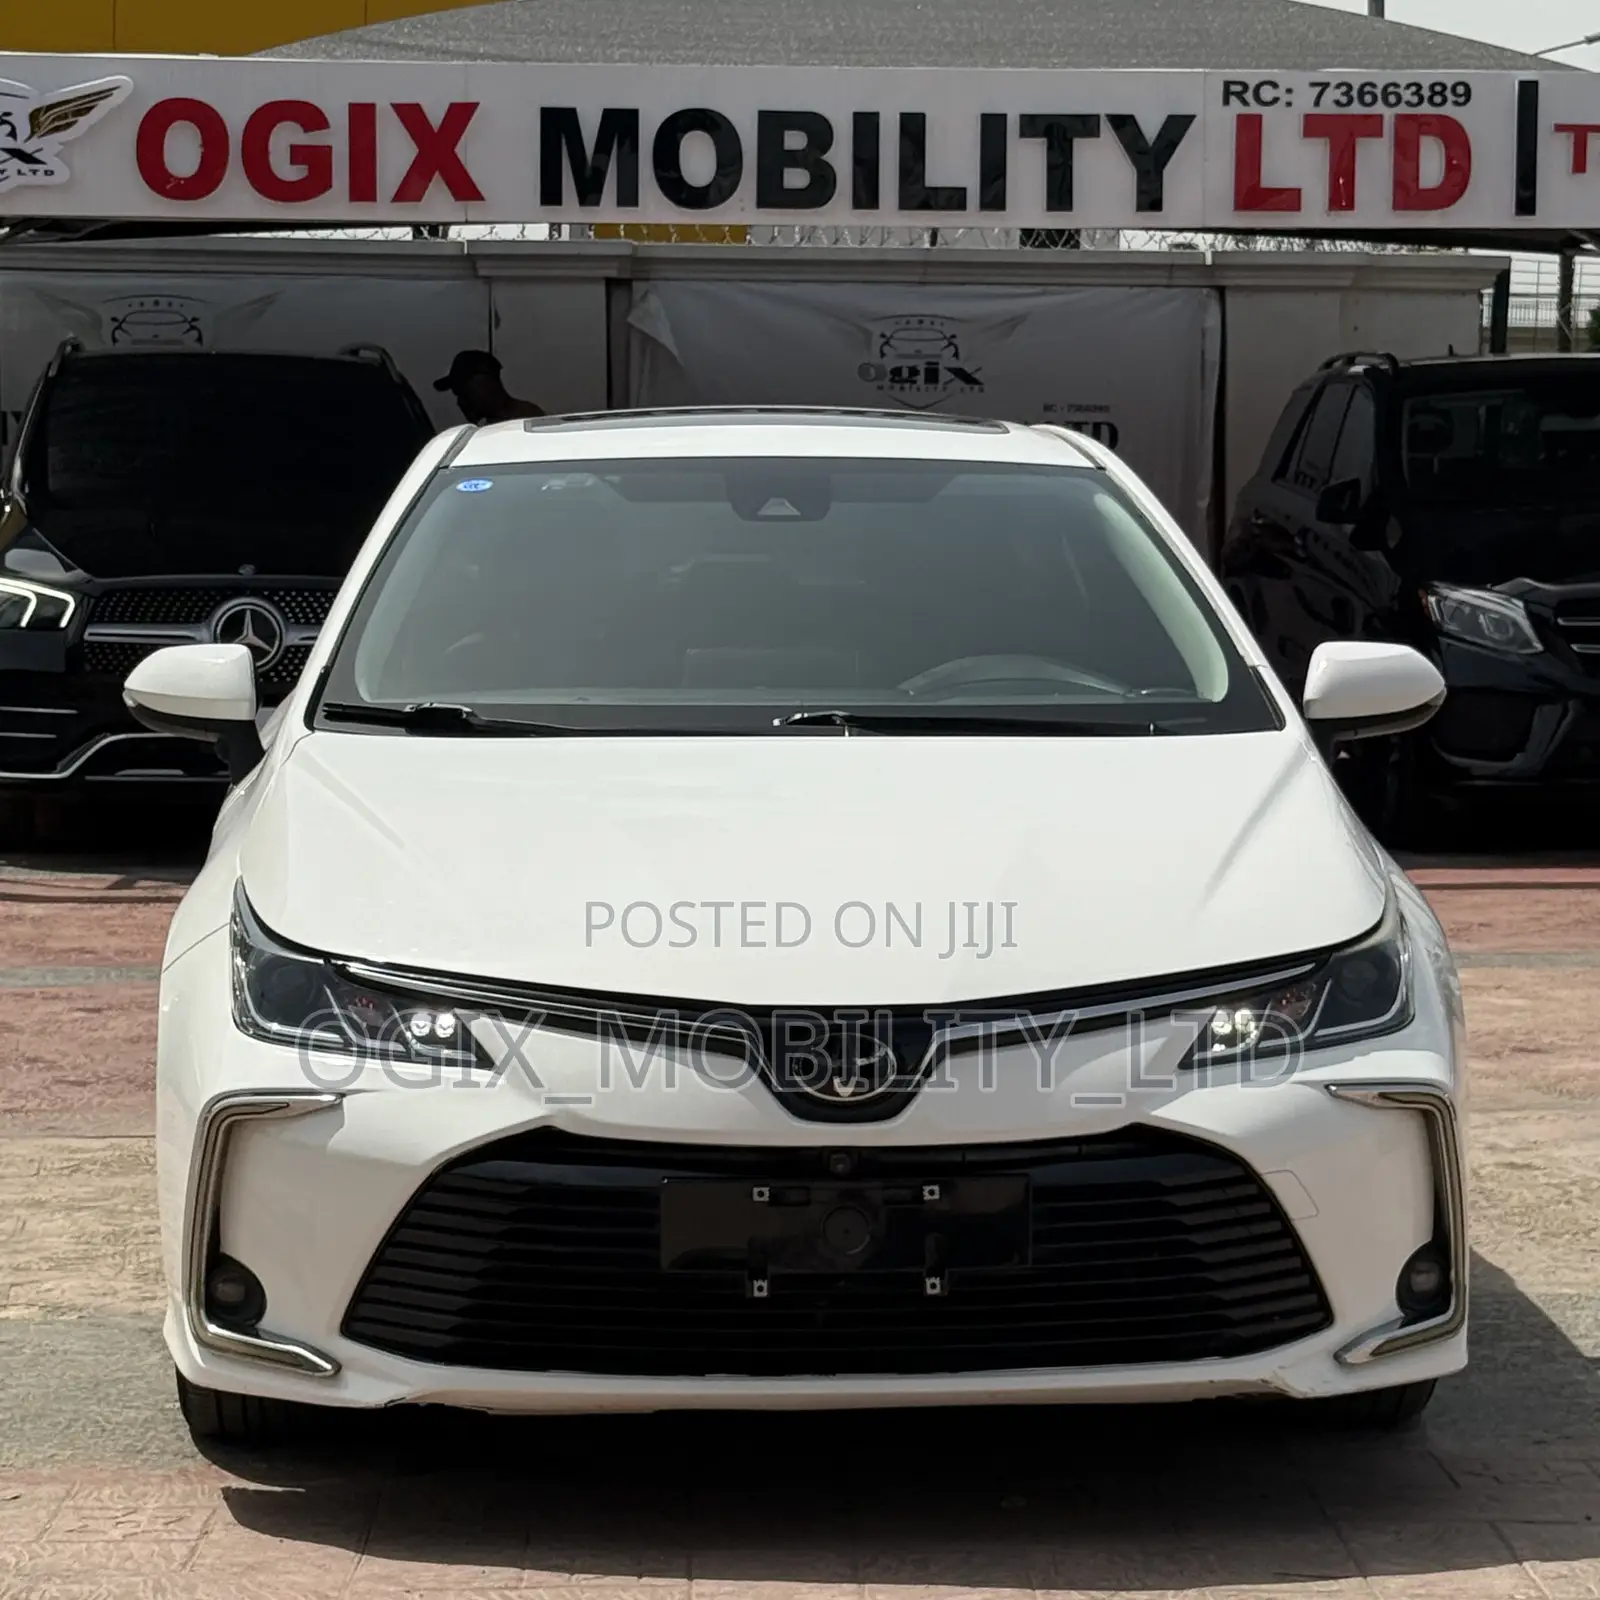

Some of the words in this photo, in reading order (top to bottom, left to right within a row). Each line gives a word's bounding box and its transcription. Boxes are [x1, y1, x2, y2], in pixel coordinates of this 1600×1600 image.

[1222, 80, 1293, 107] RC:
[1308, 81, 1472, 108] 7366389
[136, 97, 485, 203] OGIX
[539, 107, 1196, 212] MOBILITY
[1233, 113, 1472, 212] LTD
[17, 168, 55, 176] LTD
